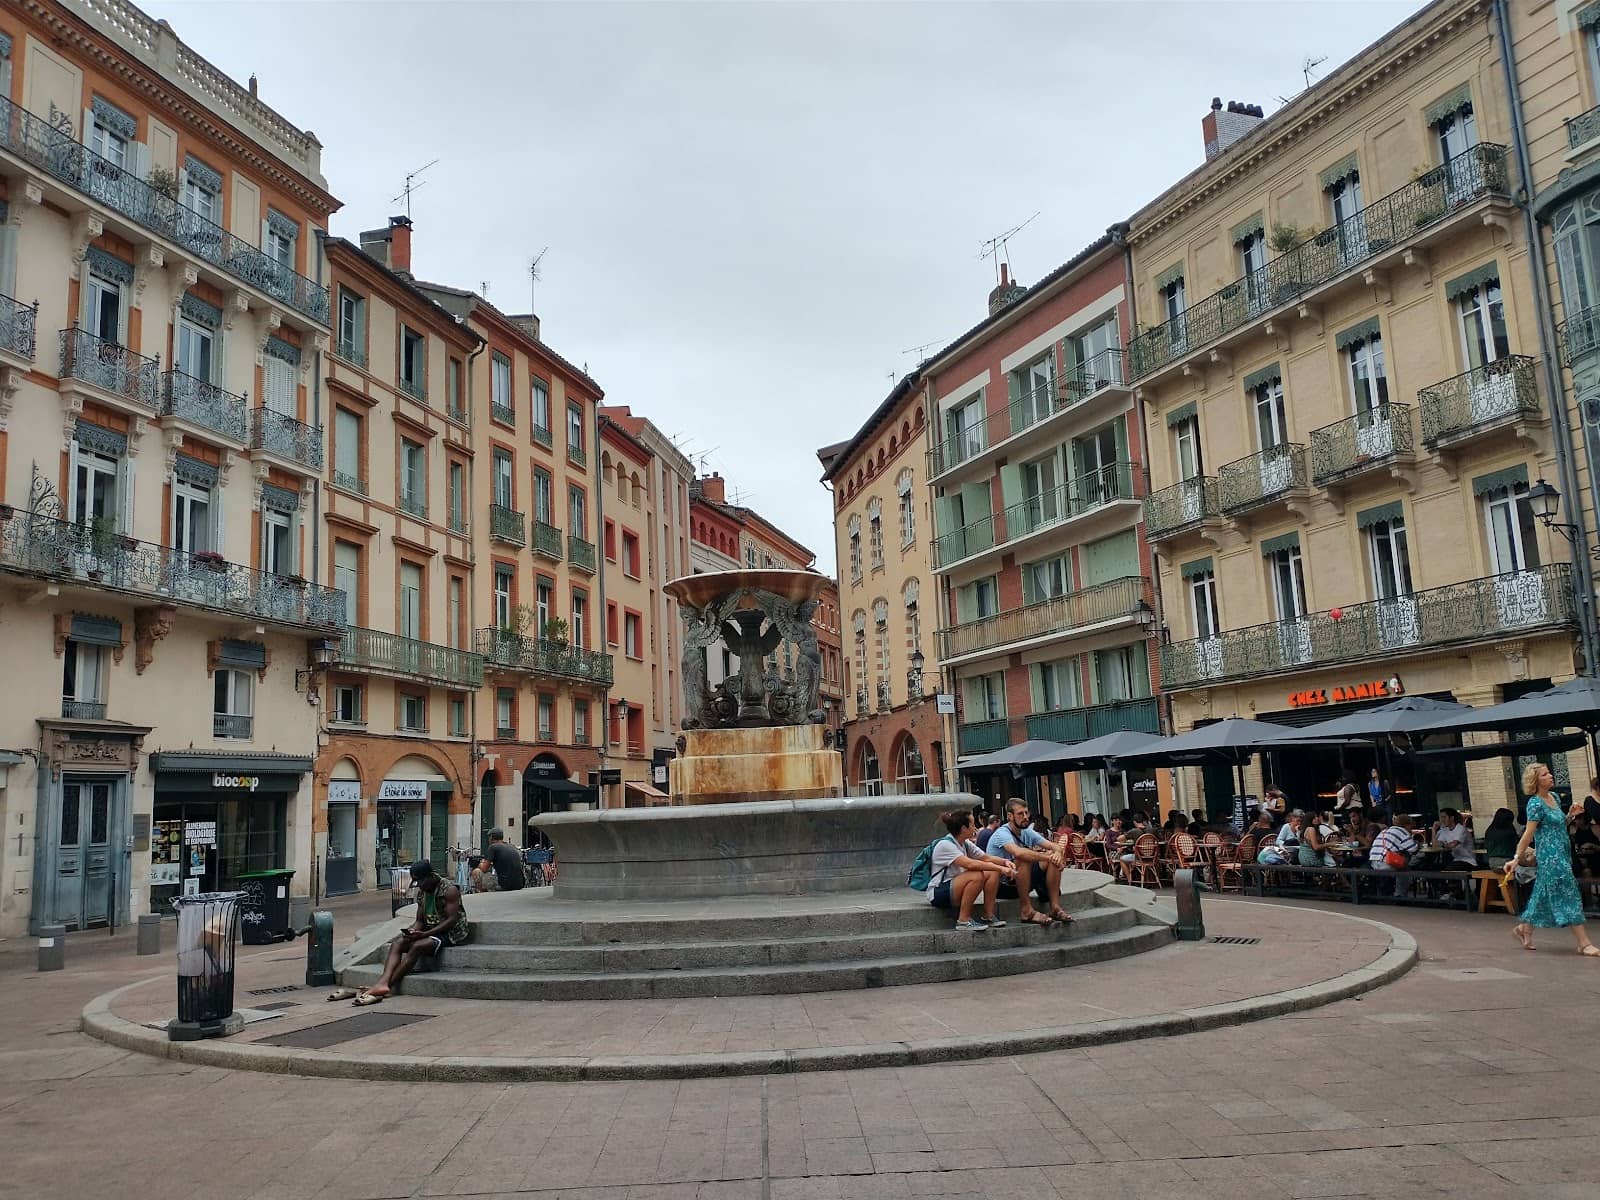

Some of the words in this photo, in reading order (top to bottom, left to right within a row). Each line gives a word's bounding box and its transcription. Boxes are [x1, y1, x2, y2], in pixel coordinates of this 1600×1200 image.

[1288, 689, 1327, 706] CHEZ
[1332, 681, 1388, 701] MAMIE
[213, 772, 259, 792] biocoop
